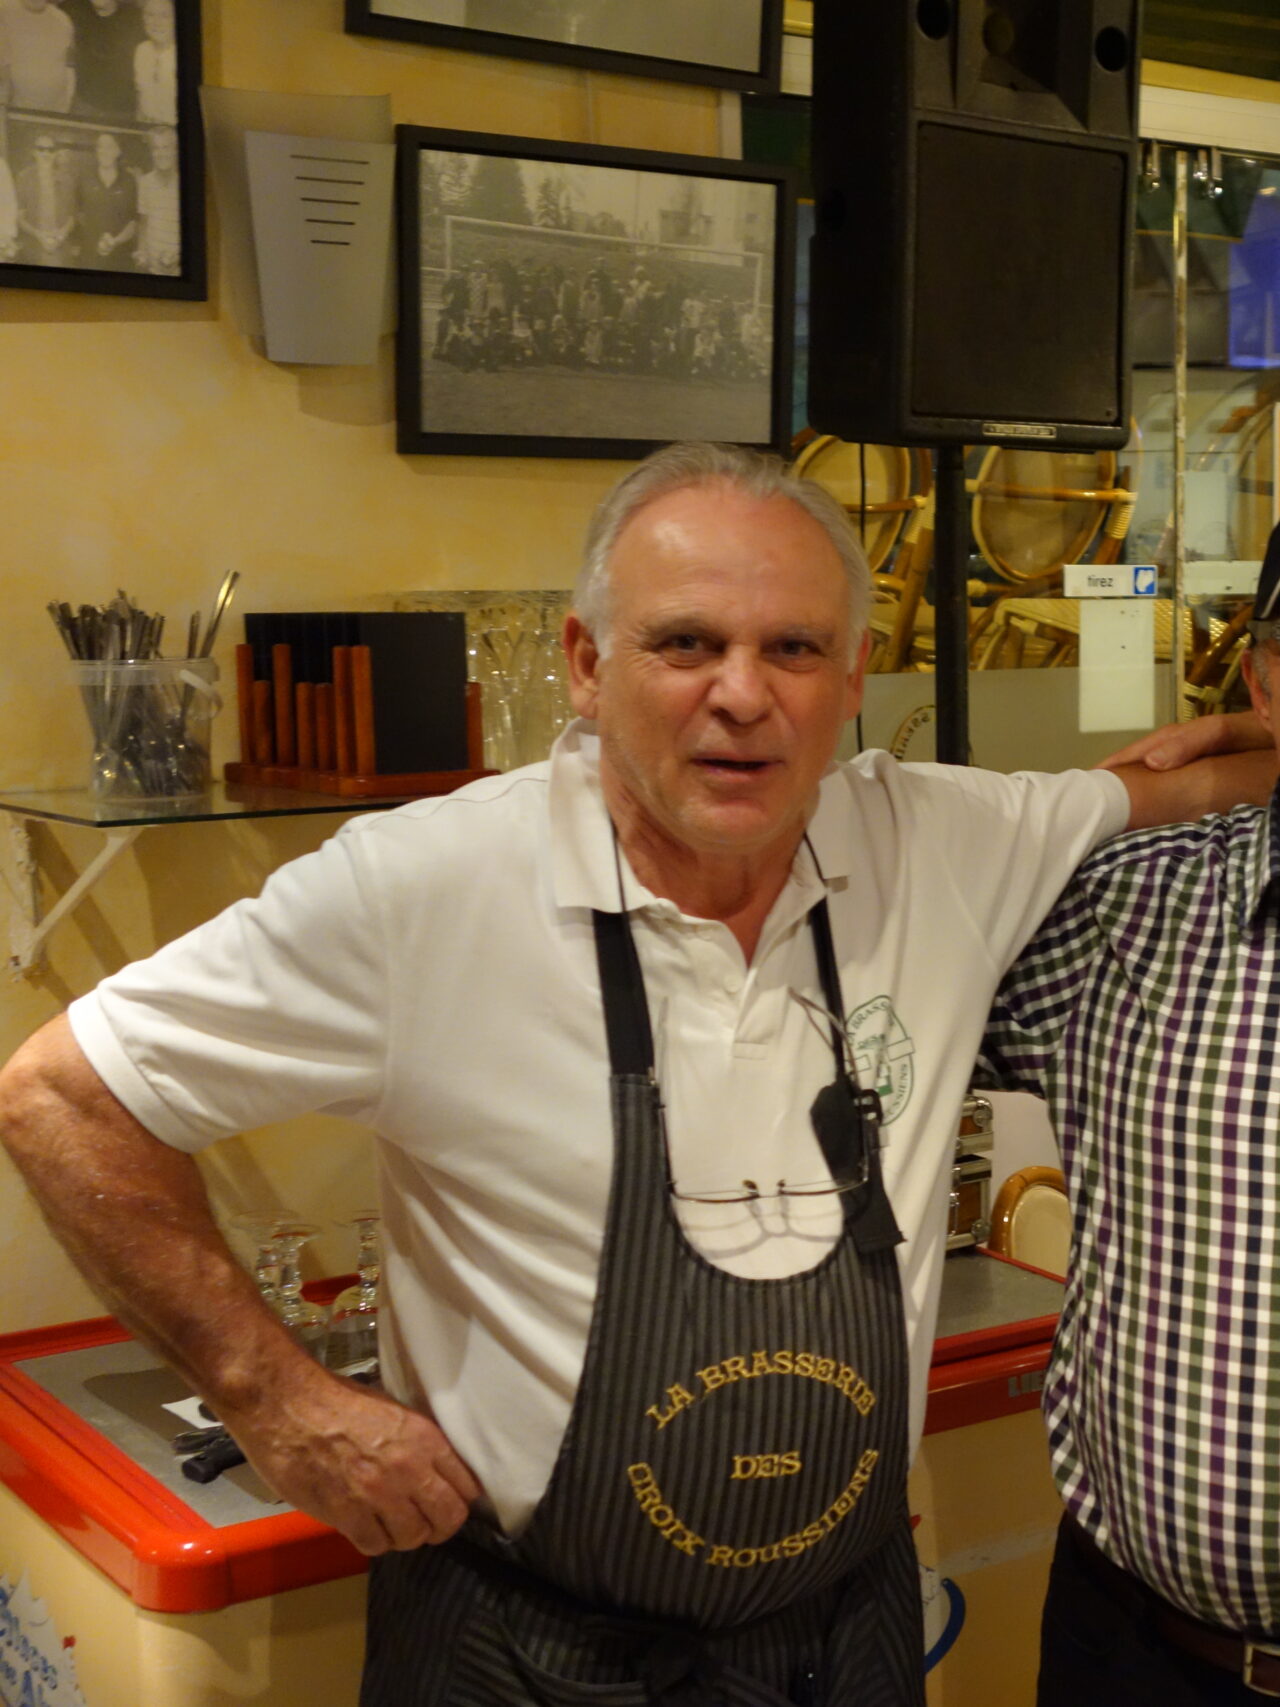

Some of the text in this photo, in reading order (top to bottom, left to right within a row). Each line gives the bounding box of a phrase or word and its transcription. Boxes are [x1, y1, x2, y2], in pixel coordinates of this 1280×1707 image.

[1087, 575, 1114, 588] tirez
[645, 1350, 877, 1430] LA BRASSERIE
[730, 1451, 802, 1479] DES
[627, 1448, 880, 1567] CROIX ROUSSIENS
